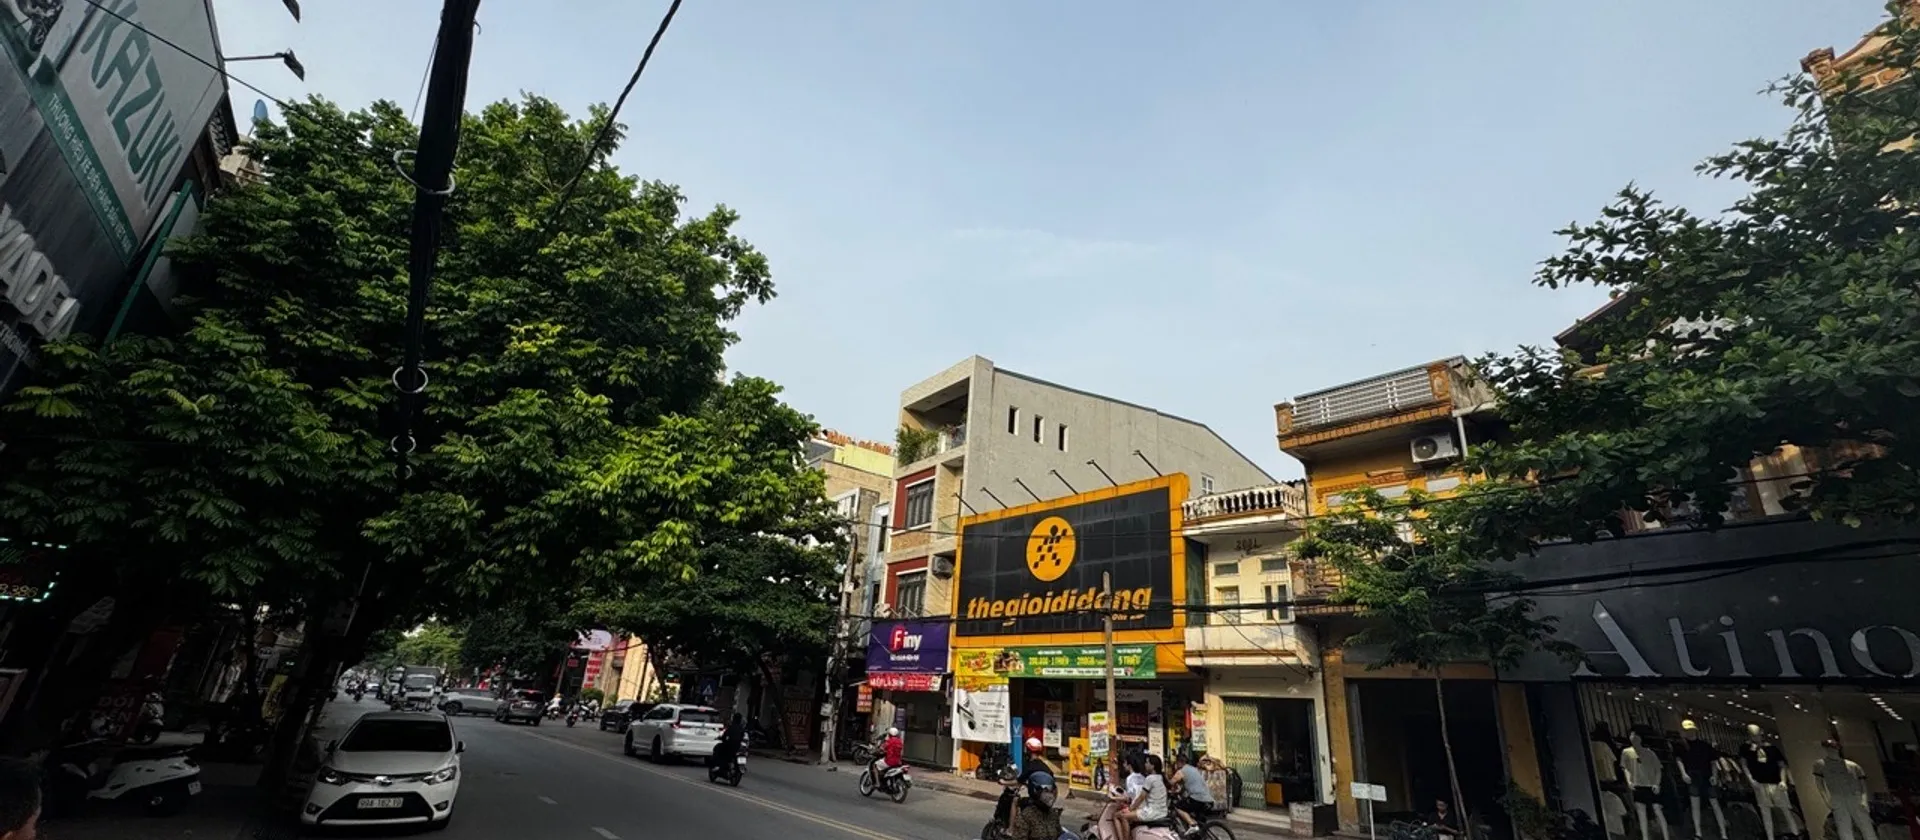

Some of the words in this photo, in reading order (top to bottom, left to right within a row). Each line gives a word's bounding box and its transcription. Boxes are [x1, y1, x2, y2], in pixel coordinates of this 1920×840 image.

[81, 0, 182, 208] KAZUKI
[893, 630, 923, 651] Finy
[1572, 600, 1920, 678] Atino
